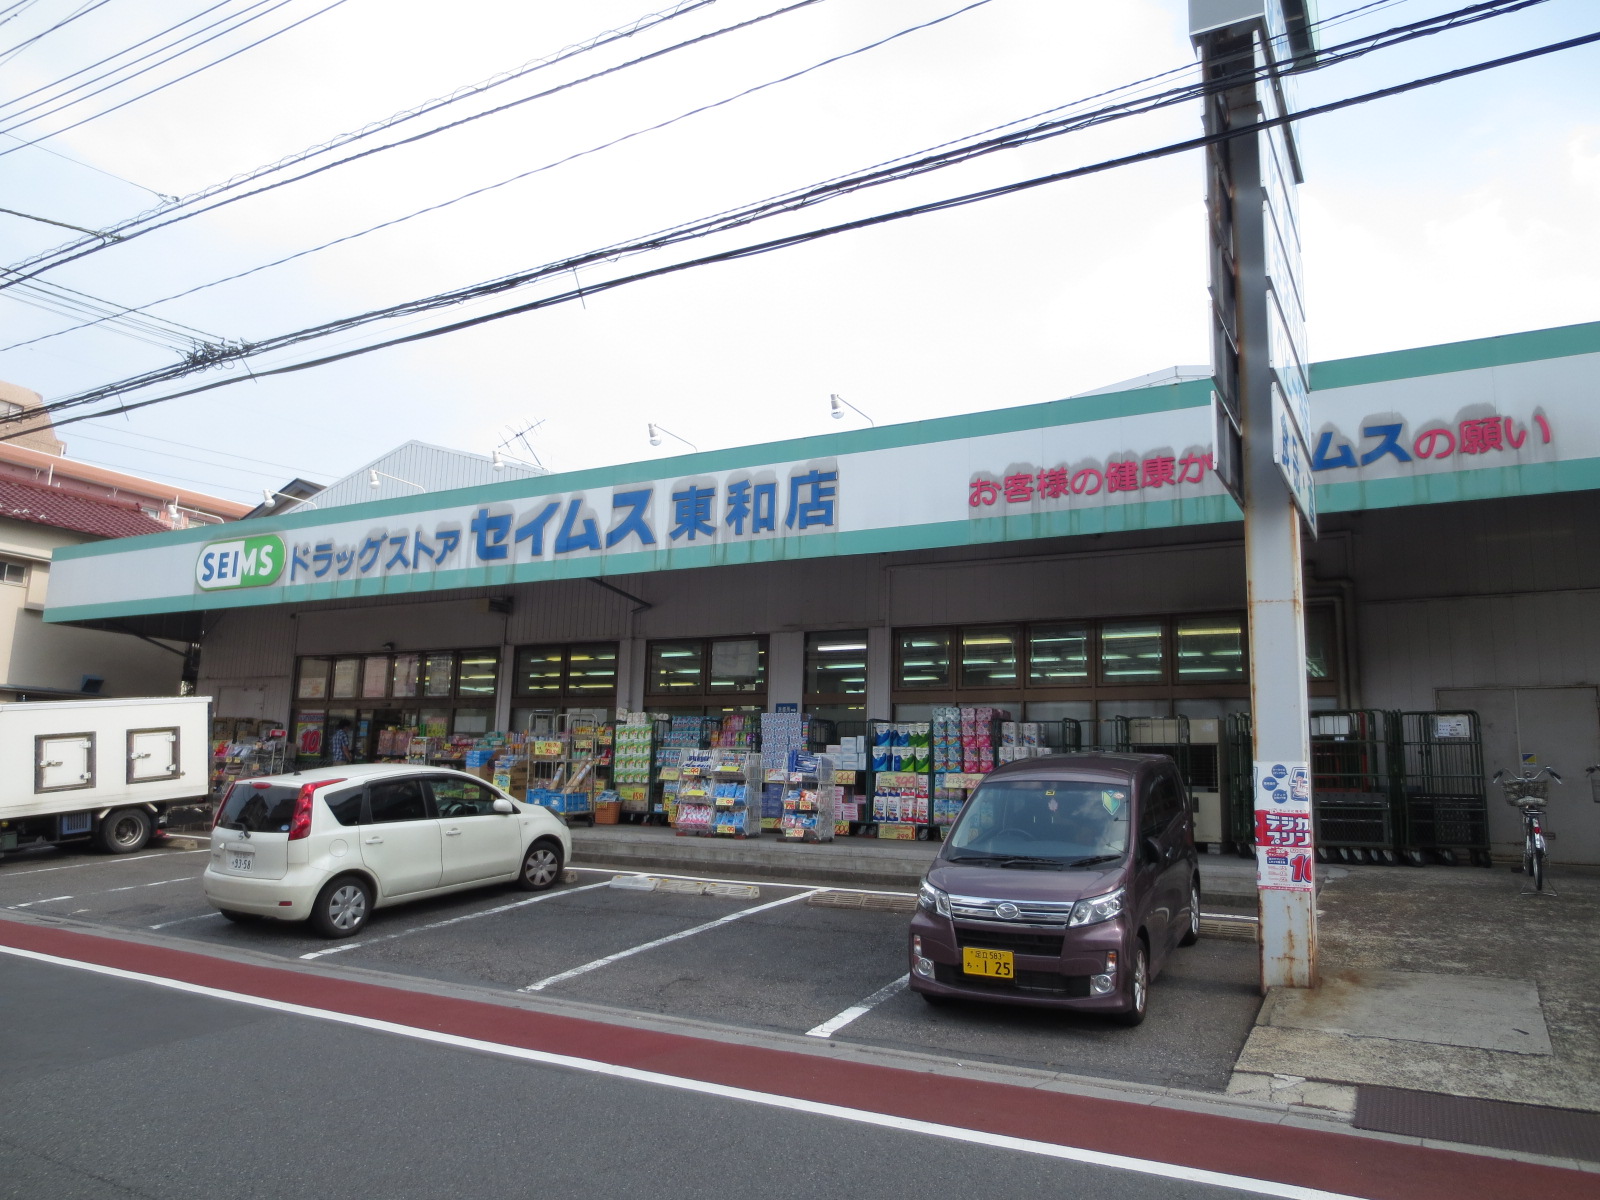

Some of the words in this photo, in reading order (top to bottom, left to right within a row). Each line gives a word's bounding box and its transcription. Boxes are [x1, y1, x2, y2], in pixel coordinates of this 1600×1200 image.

[1311, 414, 1550, 472] ムスの願い
[969, 452, 1214, 507] お客様の健康が
[202, 545, 273, 582] SEIMS
[290, 529, 461, 582] ドラッグストア
